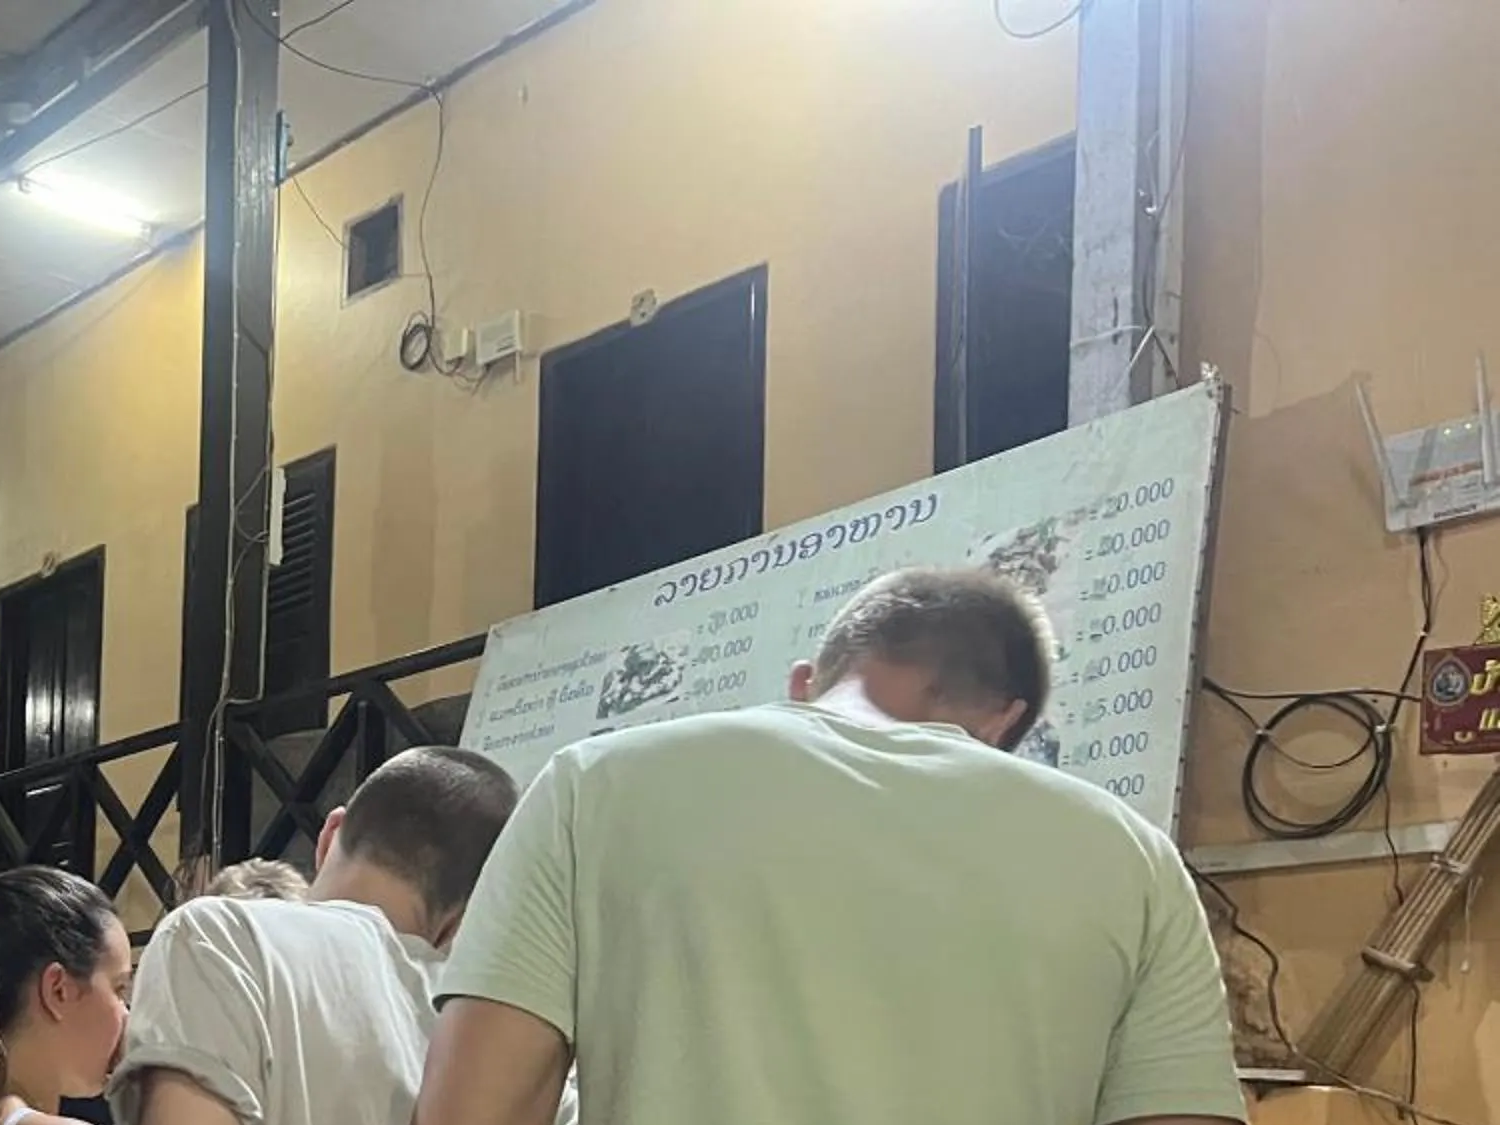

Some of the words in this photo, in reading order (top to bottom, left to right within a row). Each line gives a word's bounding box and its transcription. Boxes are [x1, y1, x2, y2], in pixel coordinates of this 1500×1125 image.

[653, 493, 938, 607] ລາຍການອາຫານ
